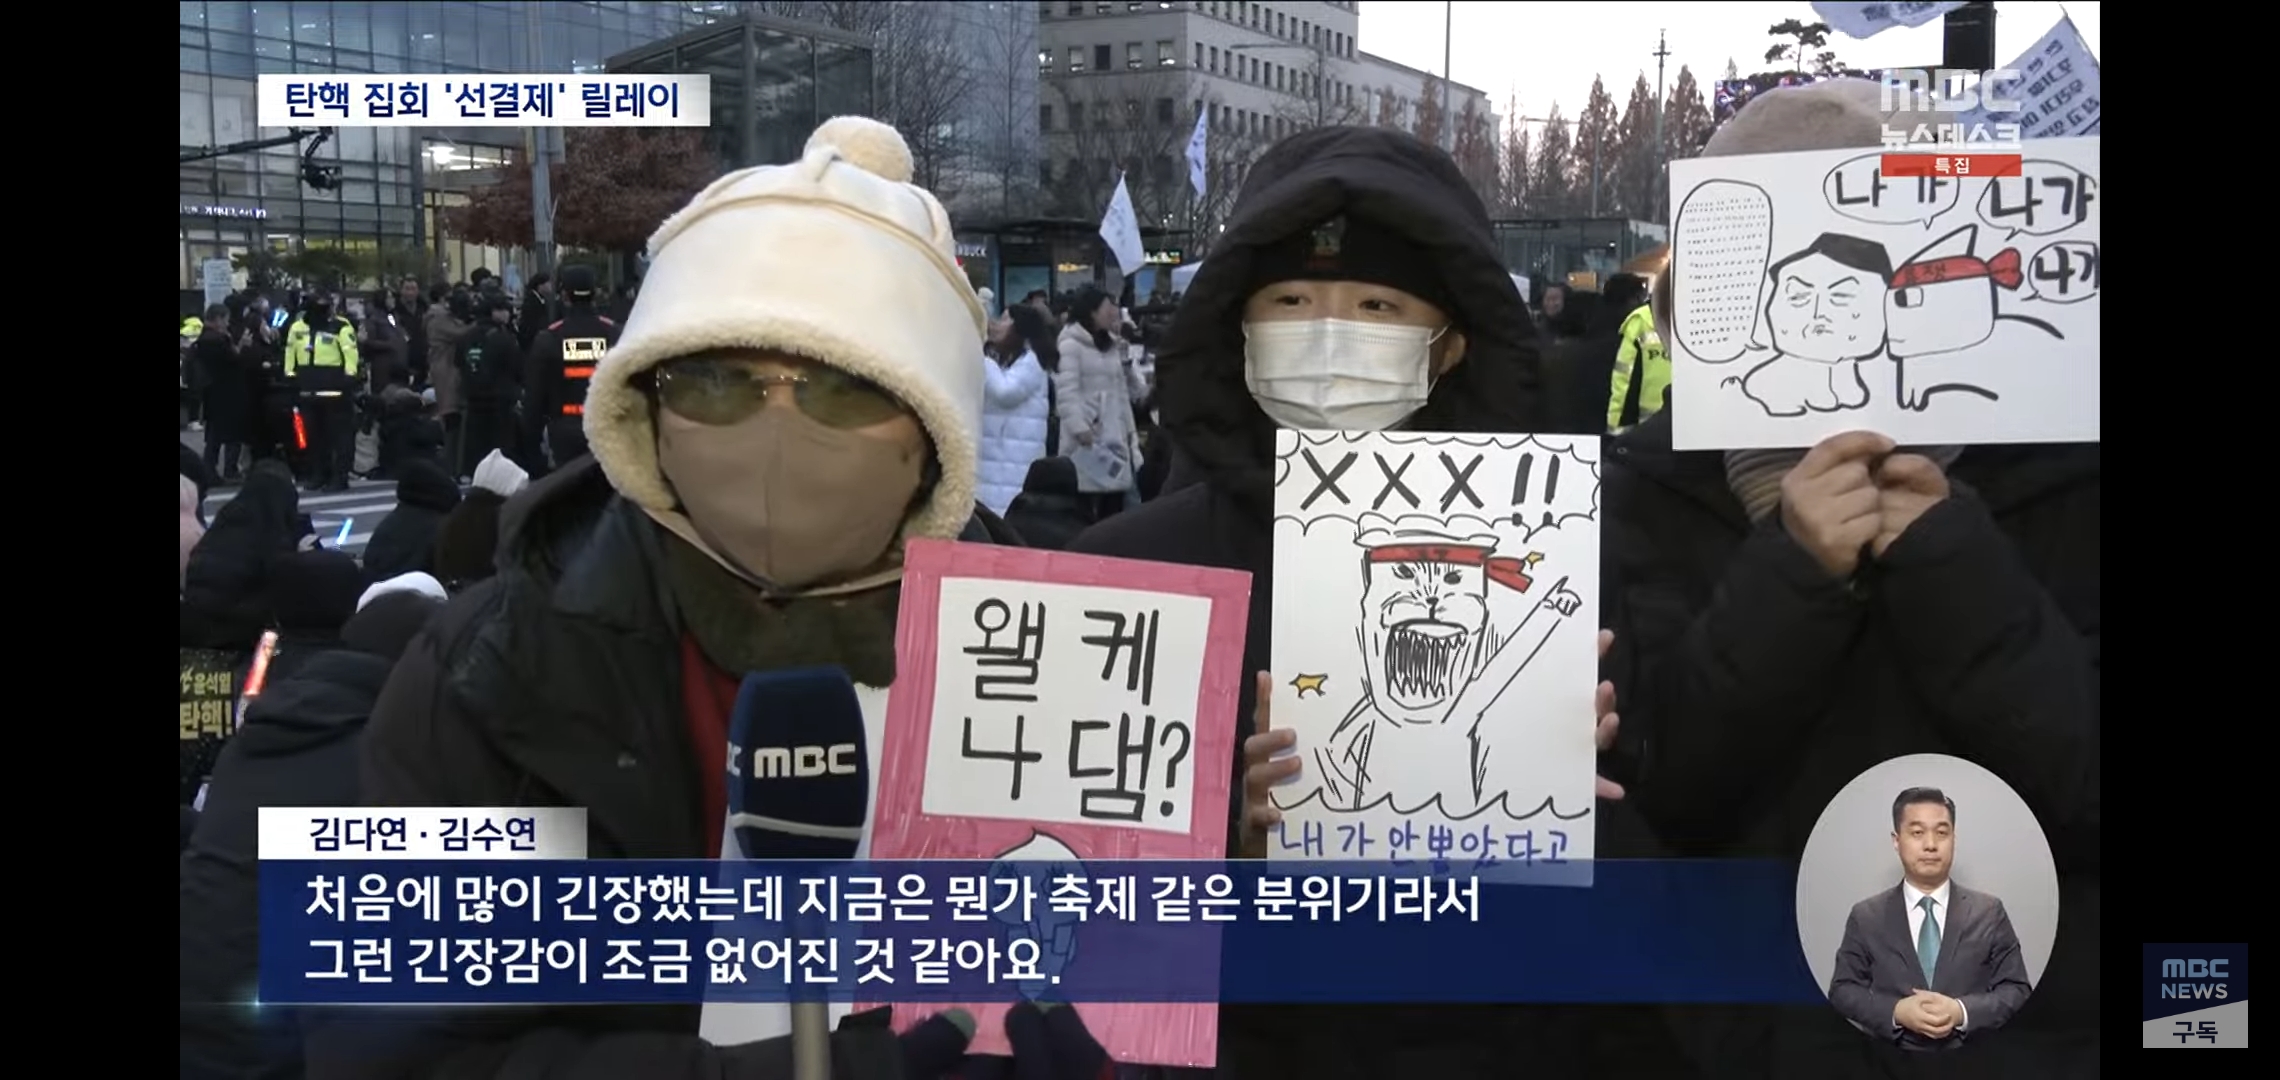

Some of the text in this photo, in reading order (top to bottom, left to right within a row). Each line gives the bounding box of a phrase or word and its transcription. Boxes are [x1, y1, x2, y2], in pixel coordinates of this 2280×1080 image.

[1990, 172, 2094, 226] 나가
[180, 700, 233, 739] 탄핵!
[754, 743, 857, 778] MBC
